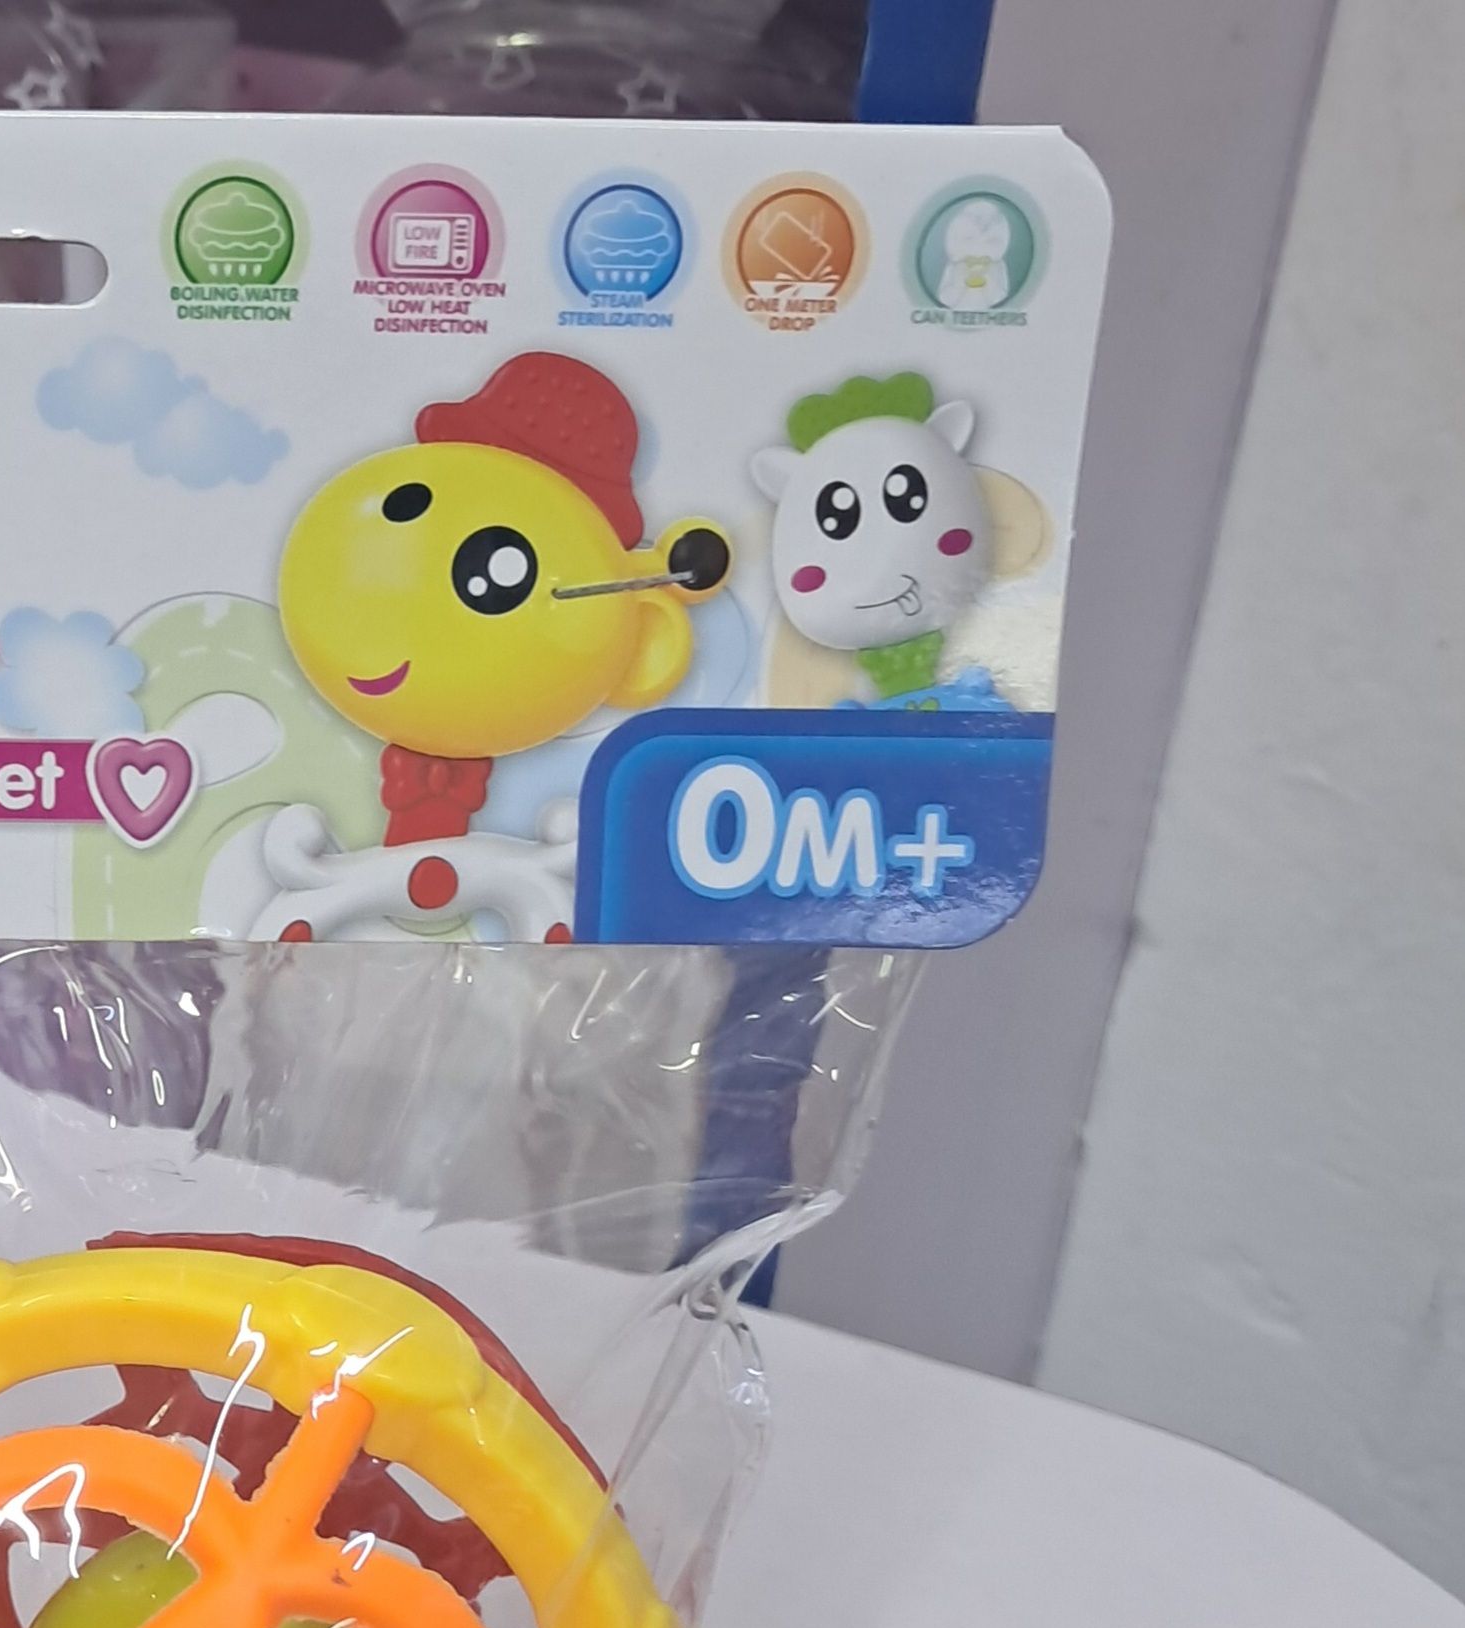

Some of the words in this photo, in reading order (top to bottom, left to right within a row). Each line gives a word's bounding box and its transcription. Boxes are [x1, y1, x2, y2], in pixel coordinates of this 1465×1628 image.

[403, 226, 442, 241] LOW
[404, 244, 438, 260] FIRE
[169, 285, 240, 302] BOILING
[245, 287, 300, 303] WATER
[353, 279, 455, 297] MICROWAVE
[460, 282, 507, 298] OVEN
[387, 300, 427, 315] LOW
[430, 300, 472, 316] HEAT
[590, 293, 645, 308] STEAM
[744, 297, 780, 313] ONE
[784, 298, 837, 314] METER
[176, 304, 291, 321] DISINFECTION
[557, 311, 674, 328] STERILIZATION
[910, 309, 946, 325] CAN
[952, 310, 1028, 327] TEETHERS
[373, 317, 489, 335] DISINFECTION
[768, 316, 815, 332] DROP
